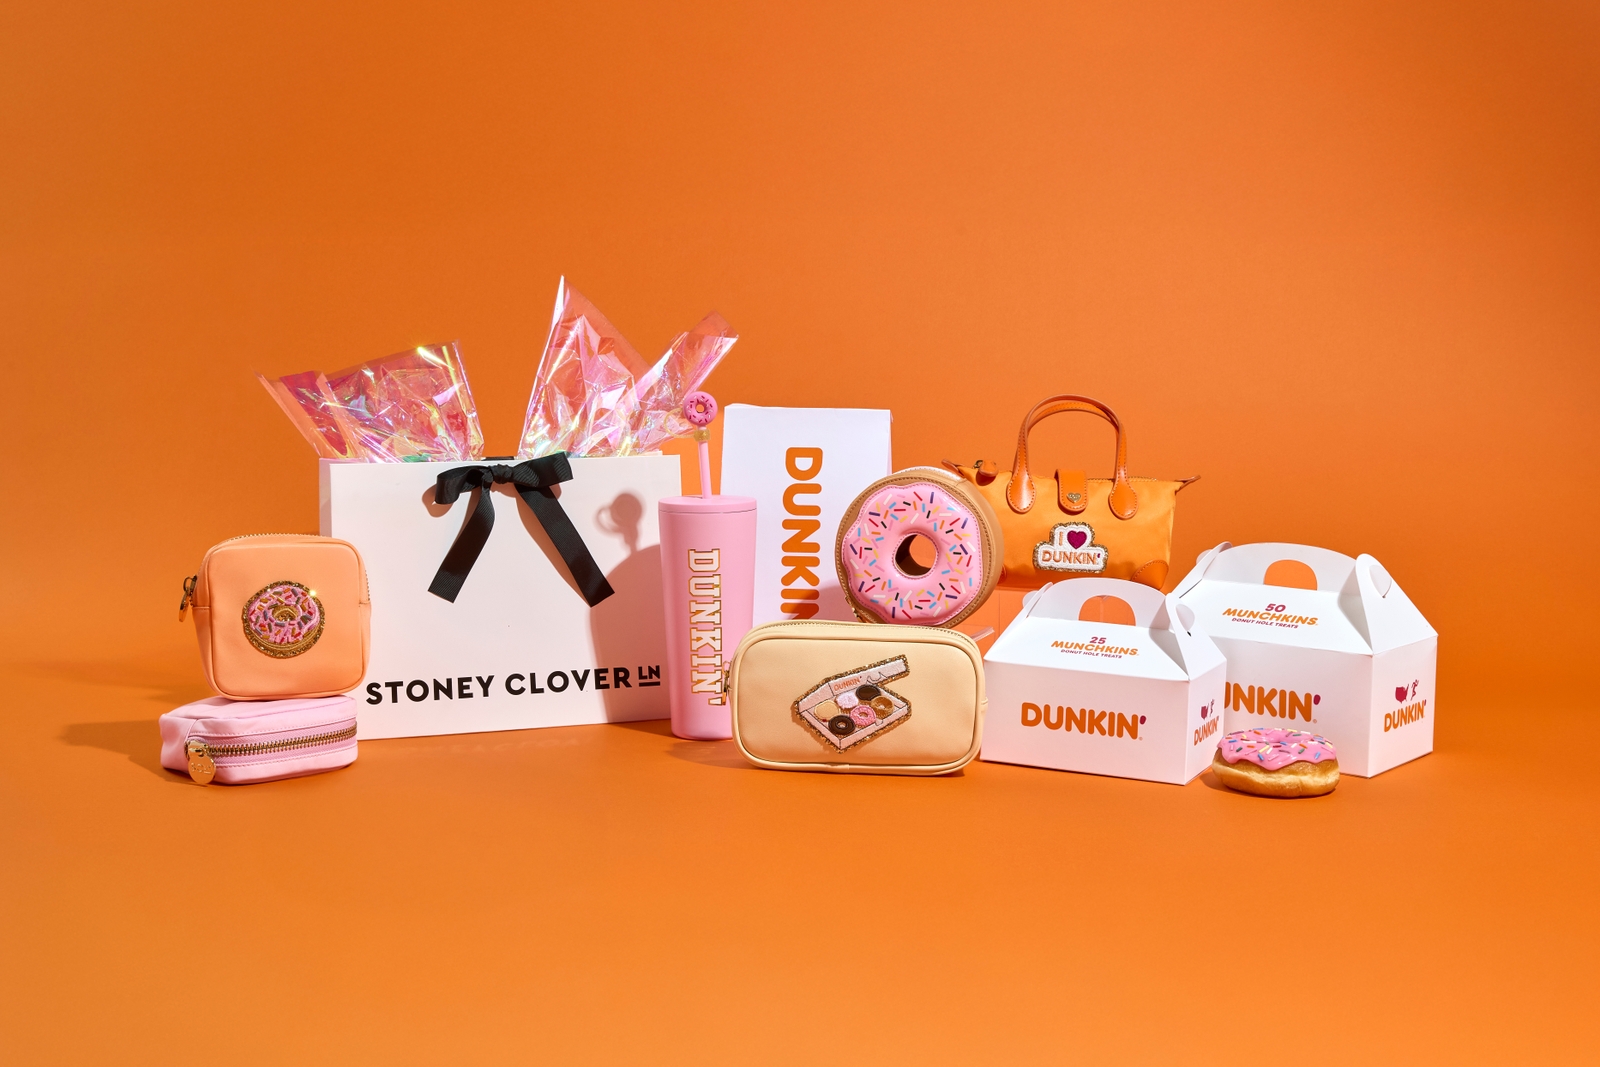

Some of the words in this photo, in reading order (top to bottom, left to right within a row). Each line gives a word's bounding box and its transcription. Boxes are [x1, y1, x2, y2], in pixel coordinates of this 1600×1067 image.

[1058, 531, 1064, 546] I
[1042, 550, 1100, 565] DUNKIN'
[1265, 603, 1286, 612] 50
[1222, 608, 1318, 625] MUNCHKINS
[688, 549, 722, 705] DUNKIN'
[1051, 640, 1138, 656] MUNCHKINS
[1089, 636, 1107, 645] 25
[366, 674, 494, 704] STONEY
[505, 667, 632, 695] CLOVER
[638, 665, 661, 683] LN
[1021, 702, 1146, 740] DUNKIN'
[1384, 699, 1426, 733] DUNKIN'
[1194, 715, 1219, 746] DUNKIN'
